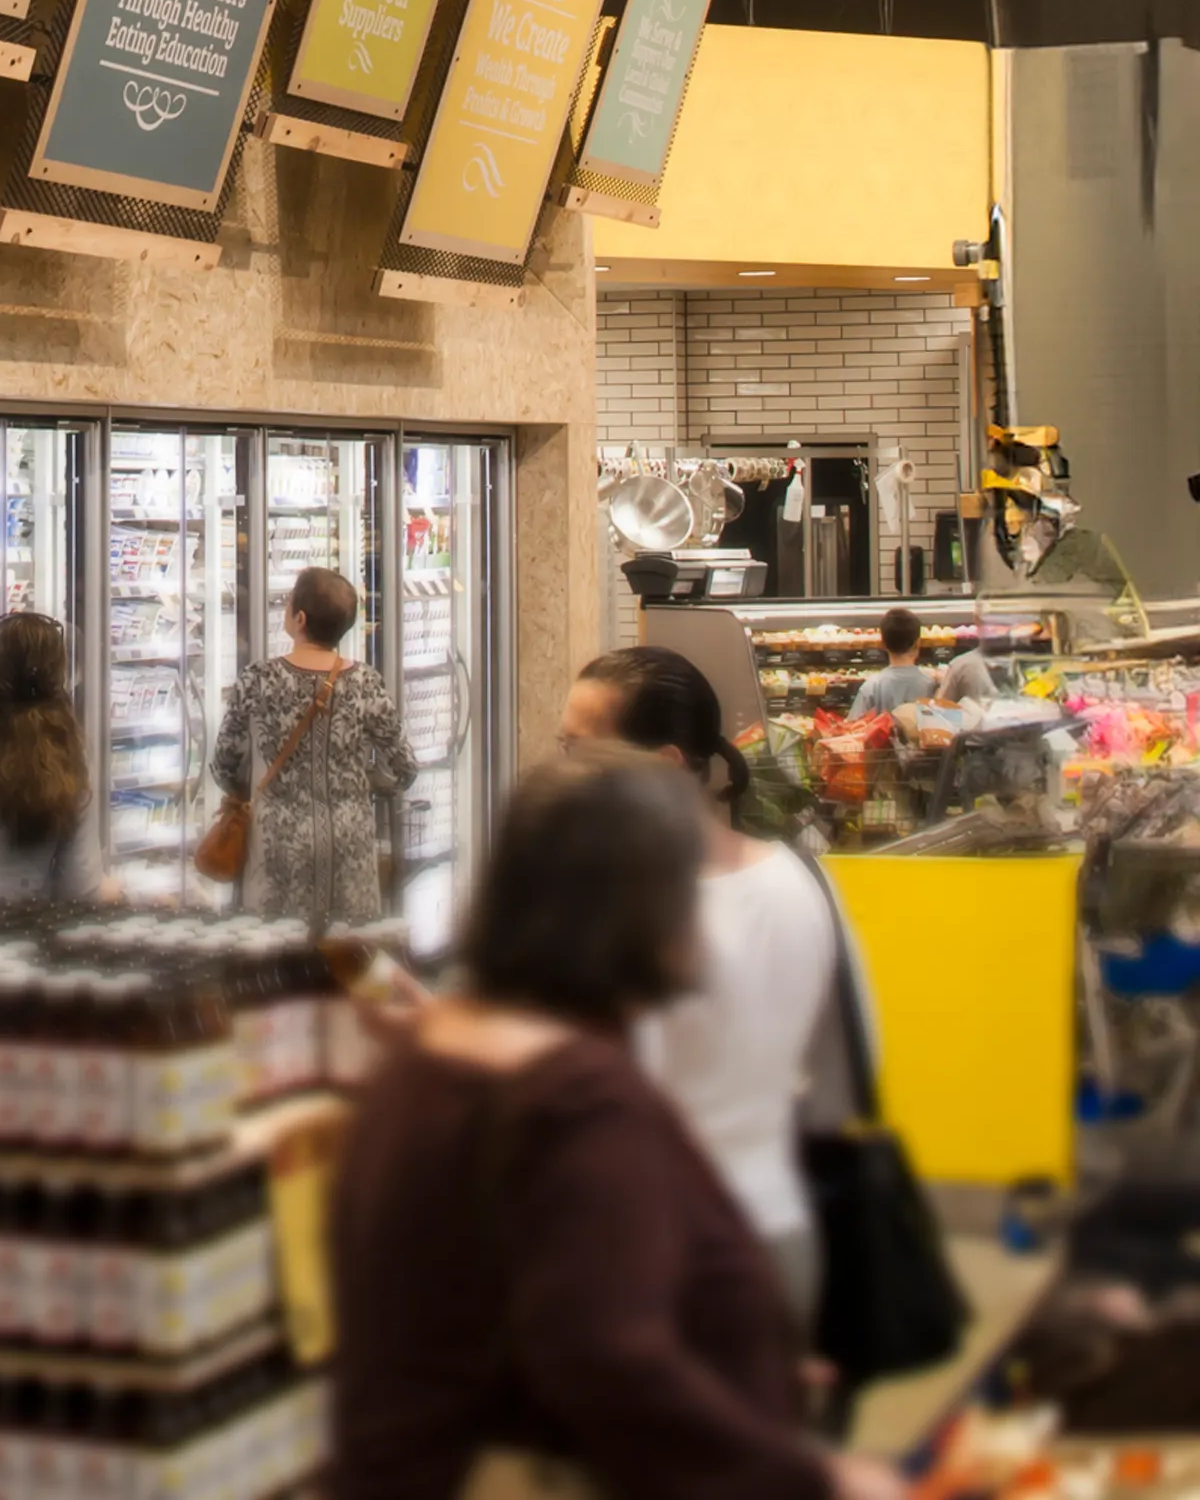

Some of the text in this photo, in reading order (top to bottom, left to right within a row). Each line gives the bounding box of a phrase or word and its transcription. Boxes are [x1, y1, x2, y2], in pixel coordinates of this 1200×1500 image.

[106, 18, 227, 77] Eating Education
[185, 1, 239, 49] Healthy
[488, 0, 570, 63] We Create
